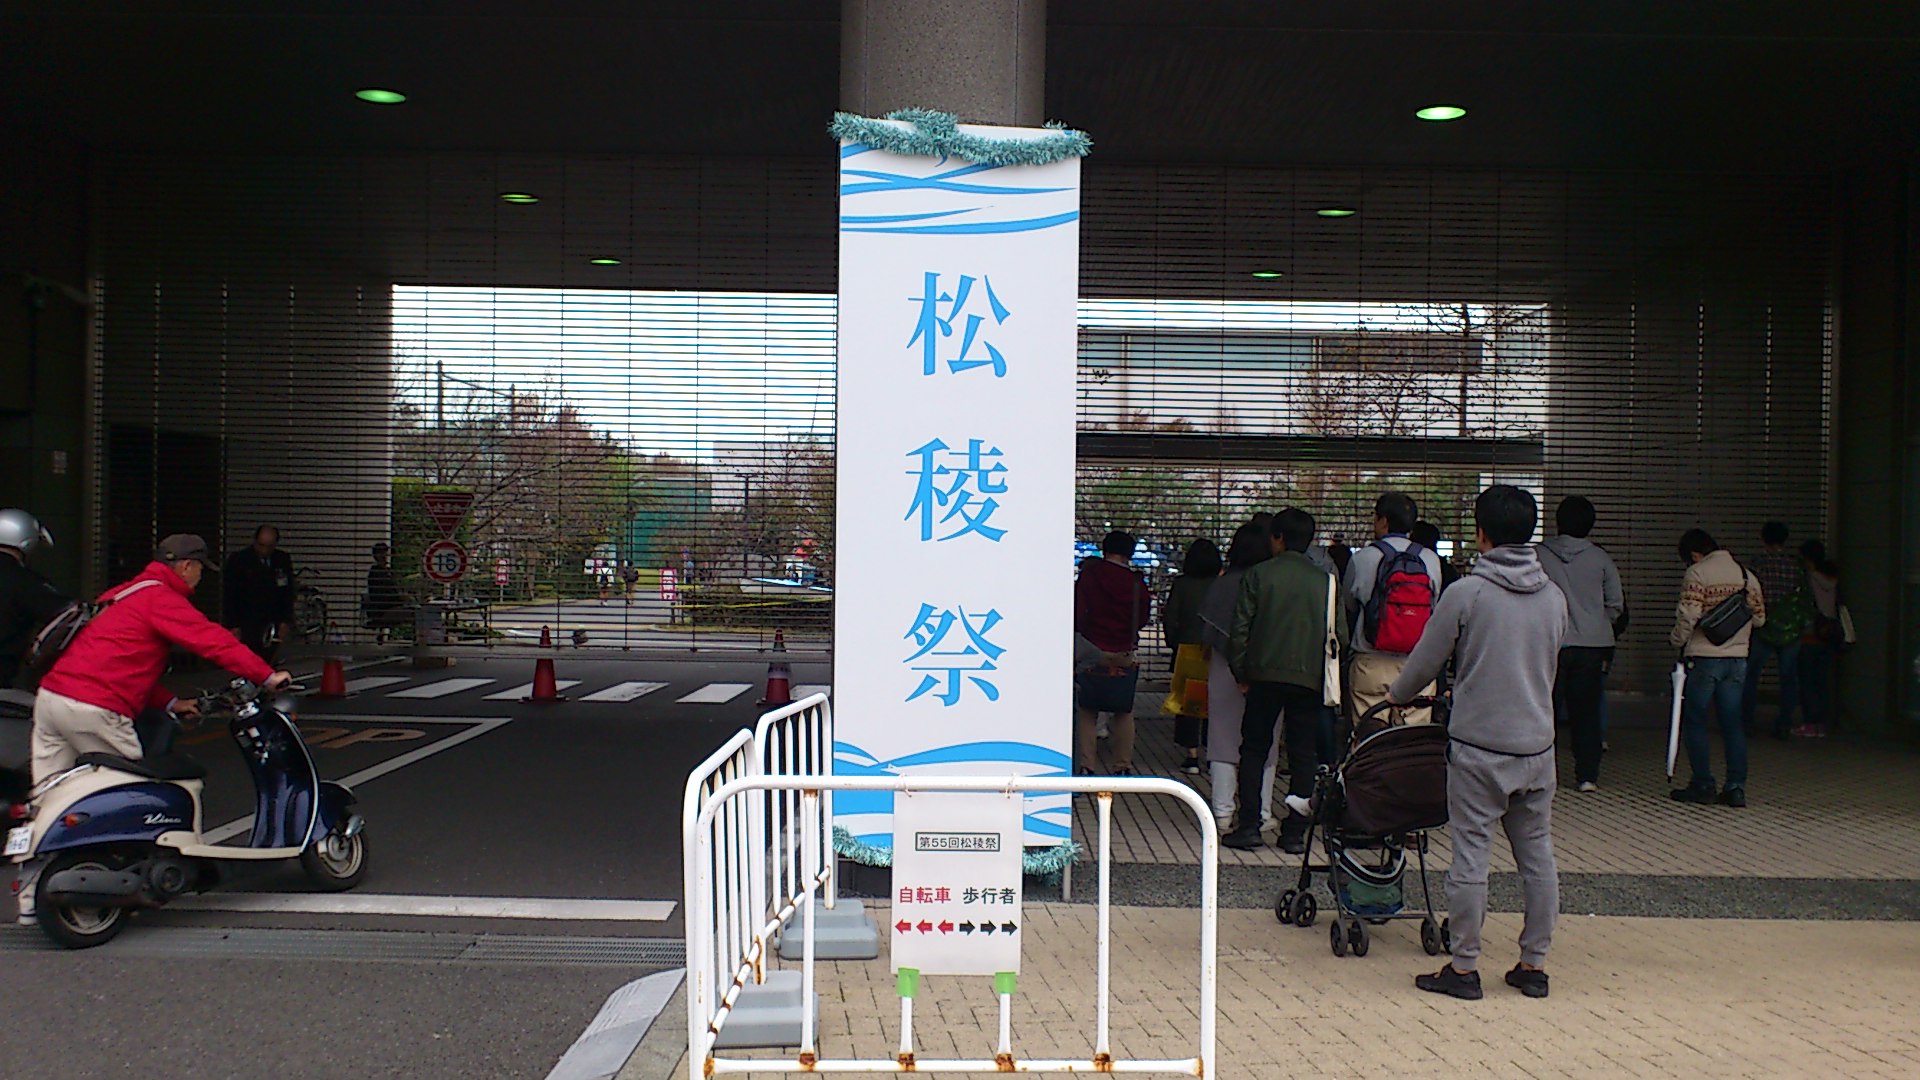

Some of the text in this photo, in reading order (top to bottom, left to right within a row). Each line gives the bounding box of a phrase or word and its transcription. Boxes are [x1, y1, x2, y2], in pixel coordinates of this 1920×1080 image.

[903, 272, 1010, 706] 松稜祭
[436, 553, 457, 571] 15
[919, 837, 998, 849] 第55回松稜祭
[899, 886, 1016, 905] 自転車 歩行者
